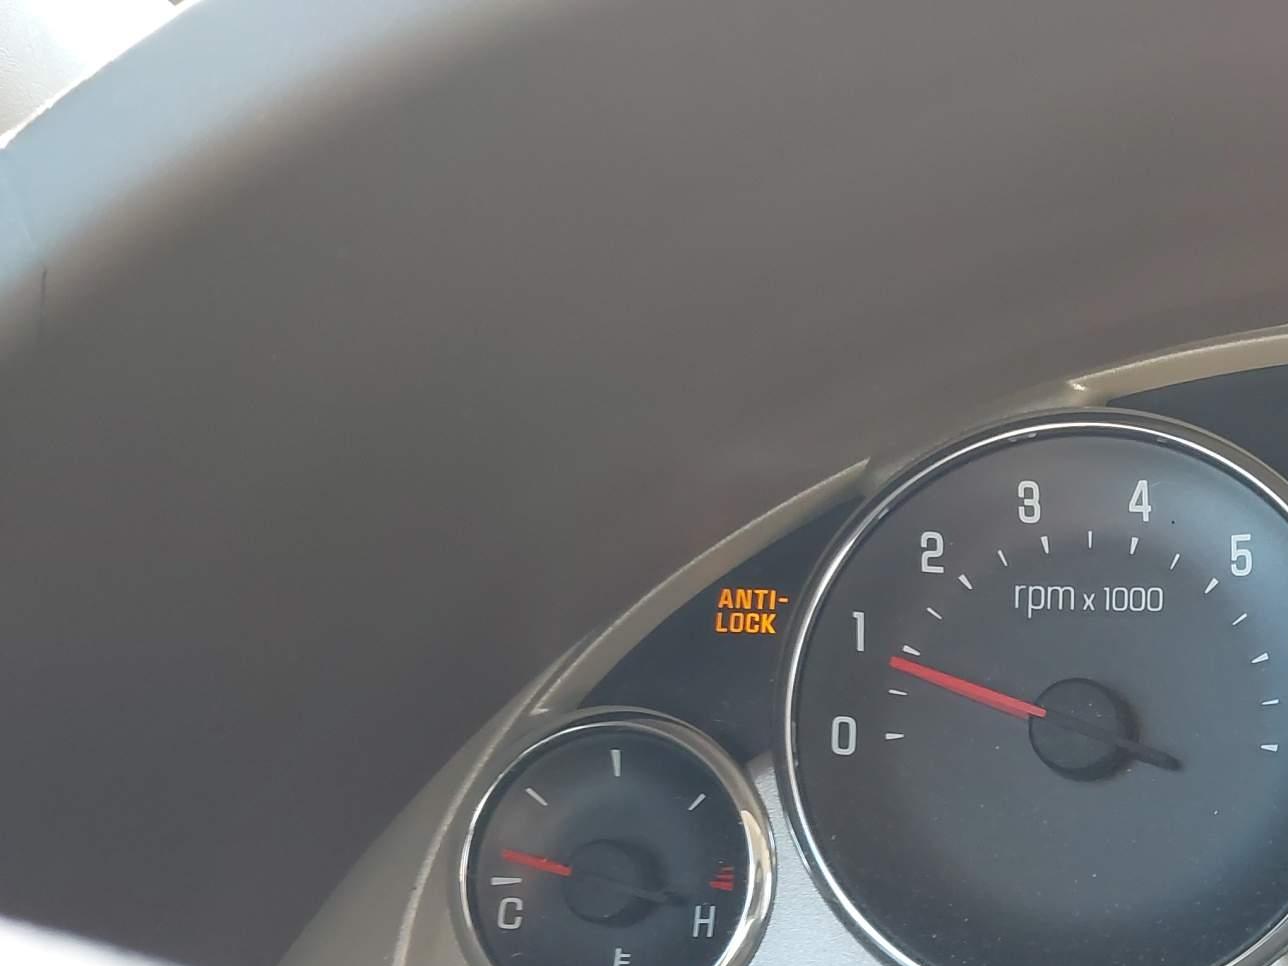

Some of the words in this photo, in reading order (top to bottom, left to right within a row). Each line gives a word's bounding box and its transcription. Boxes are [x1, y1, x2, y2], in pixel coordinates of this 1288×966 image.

[1017, 480, 1042, 524] 3
[1127, 479, 1153, 522] 4
[919, 531, 945, 574] 2
[1230, 533, 1254, 577] 5
[717, 588, 790, 610] ANTI-
[1013, 583, 1076, 619] rpm
[1103, 587, 1165, 613] 1000
[714, 612, 778, 634] LOCK
[851, 611, 867, 653] 1
[831, 715, 858, 757] 0
[497, 896, 524, 931] C
[692, 905, 717, 939] H
